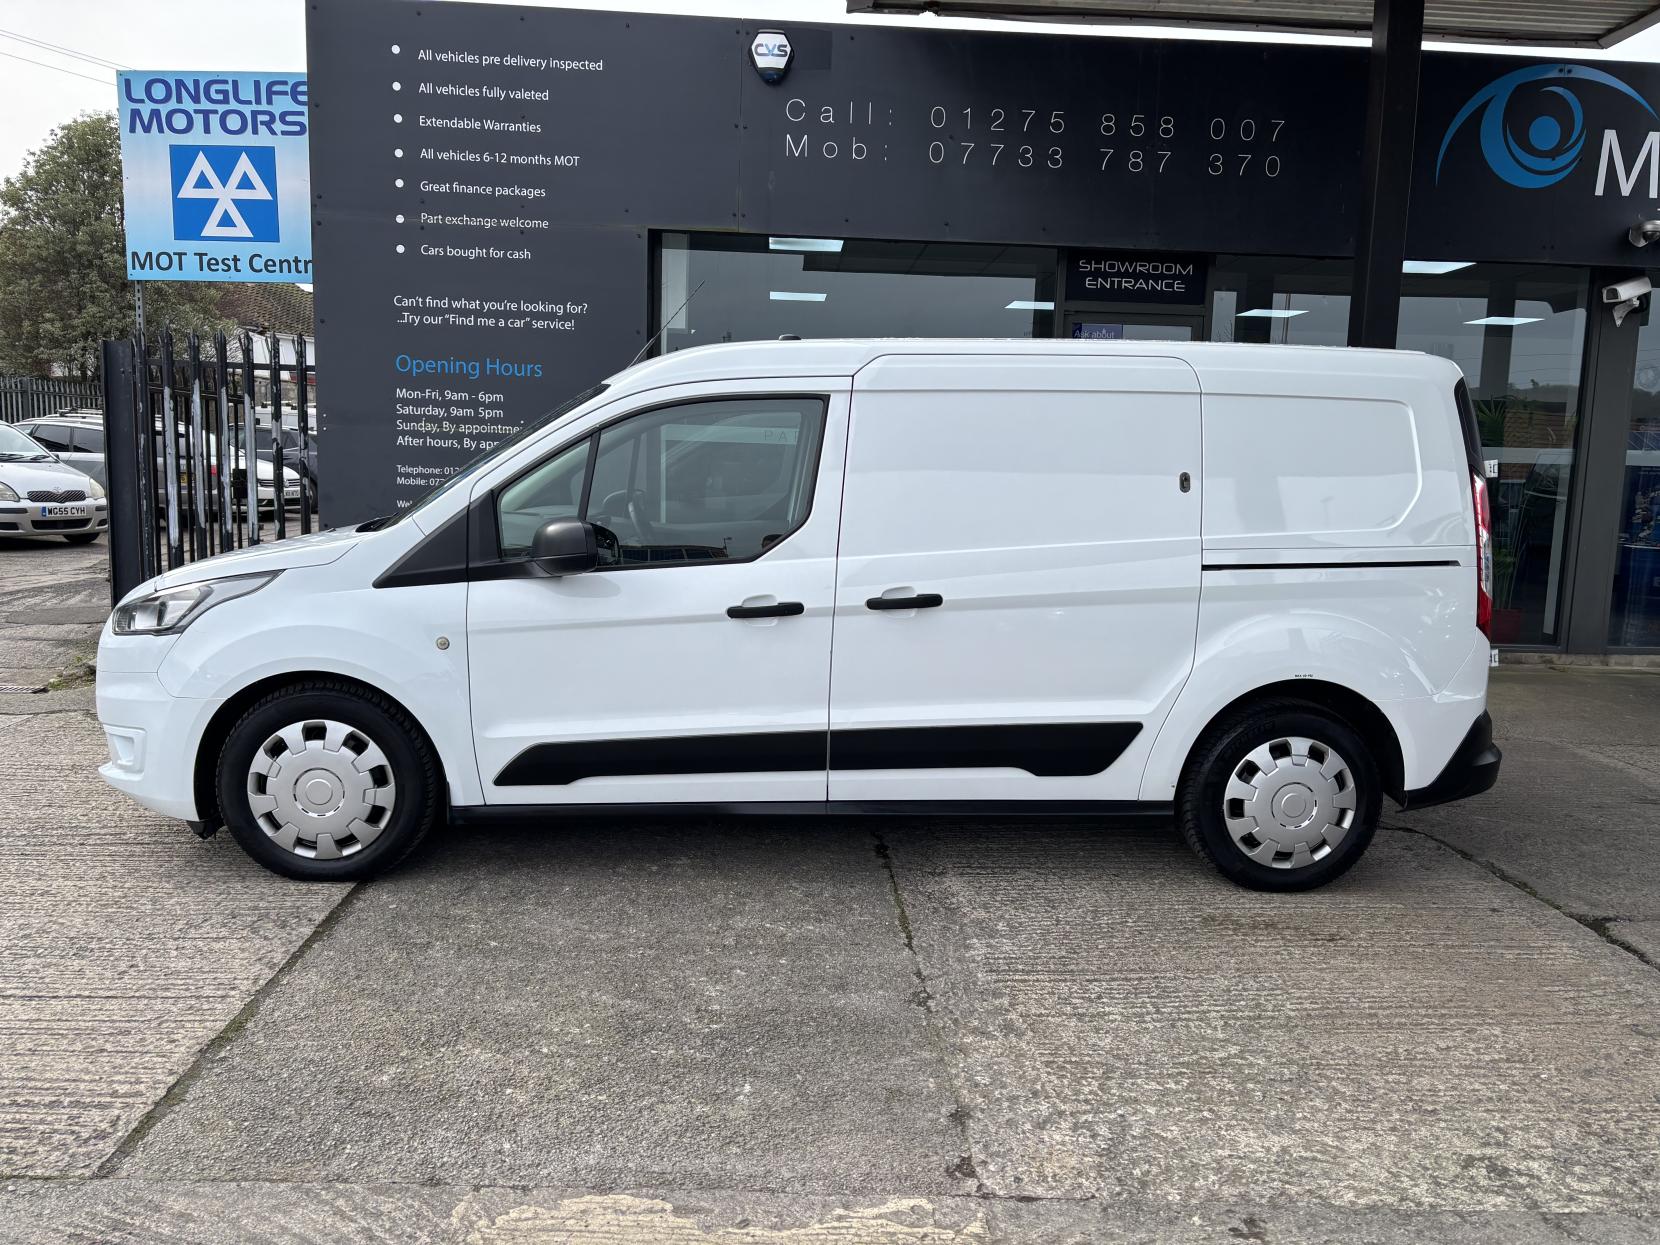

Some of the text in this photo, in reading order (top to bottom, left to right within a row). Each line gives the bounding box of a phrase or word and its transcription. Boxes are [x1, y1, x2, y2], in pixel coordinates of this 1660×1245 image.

[418, 50, 603, 71] All vehicles pre delivery inspected
[124, 78, 308, 106] LONGLIFE
[419, 83, 549, 100] All vehicles fully valeted
[129, 108, 308, 136] MOTORS
[419, 116, 541, 133] Extendable Warranties
[786, 98, 1285, 142] Call: 01275 858 007
[420, 149, 580, 166] All vehicles 6-12 months MOT
[786, 133, 1281, 177] Mob: 07733 787 370
[420, 181, 546, 198] Great finance packages
[421, 213, 549, 228] Part exchange welcome
[421, 245, 531, 260] Cars bought for cash
[131, 252, 187, 271] MOT
[194, 253, 241, 273] Test
[1079, 260, 1193, 275] SHOWROOM
[1086, 277, 1185, 292] ENTRANCE
[394, 296, 587, 315] Can't find what you're looking for?
[423, 315, 442, 324] our
[445, 315, 474, 326] "Find
[478, 317, 496, 327] me
[498, 319, 504, 327] a
[507, 318, 529, 328] car"
[532, 319, 575, 330] service!
[1074, 328, 1115, 339] Ask about
[396, 355, 543, 379] Opening Hours
[396, 389, 442, 400] Mon-Fri,
[445, 391, 469, 400] 9am
[478, 392, 504, 402] 6pm
[396, 404, 504, 418] Saturday, 9am 5pm
[396, 420, 440, 433] Sunday,
[443, 421, 456, 432] By
[397, 436, 424, 447] After
[427, 438, 460, 449] hours,
[463, 439, 477, 450] By
[396, 465, 442, 475] Telephone:
[396, 476, 428, 486] Mobile:
